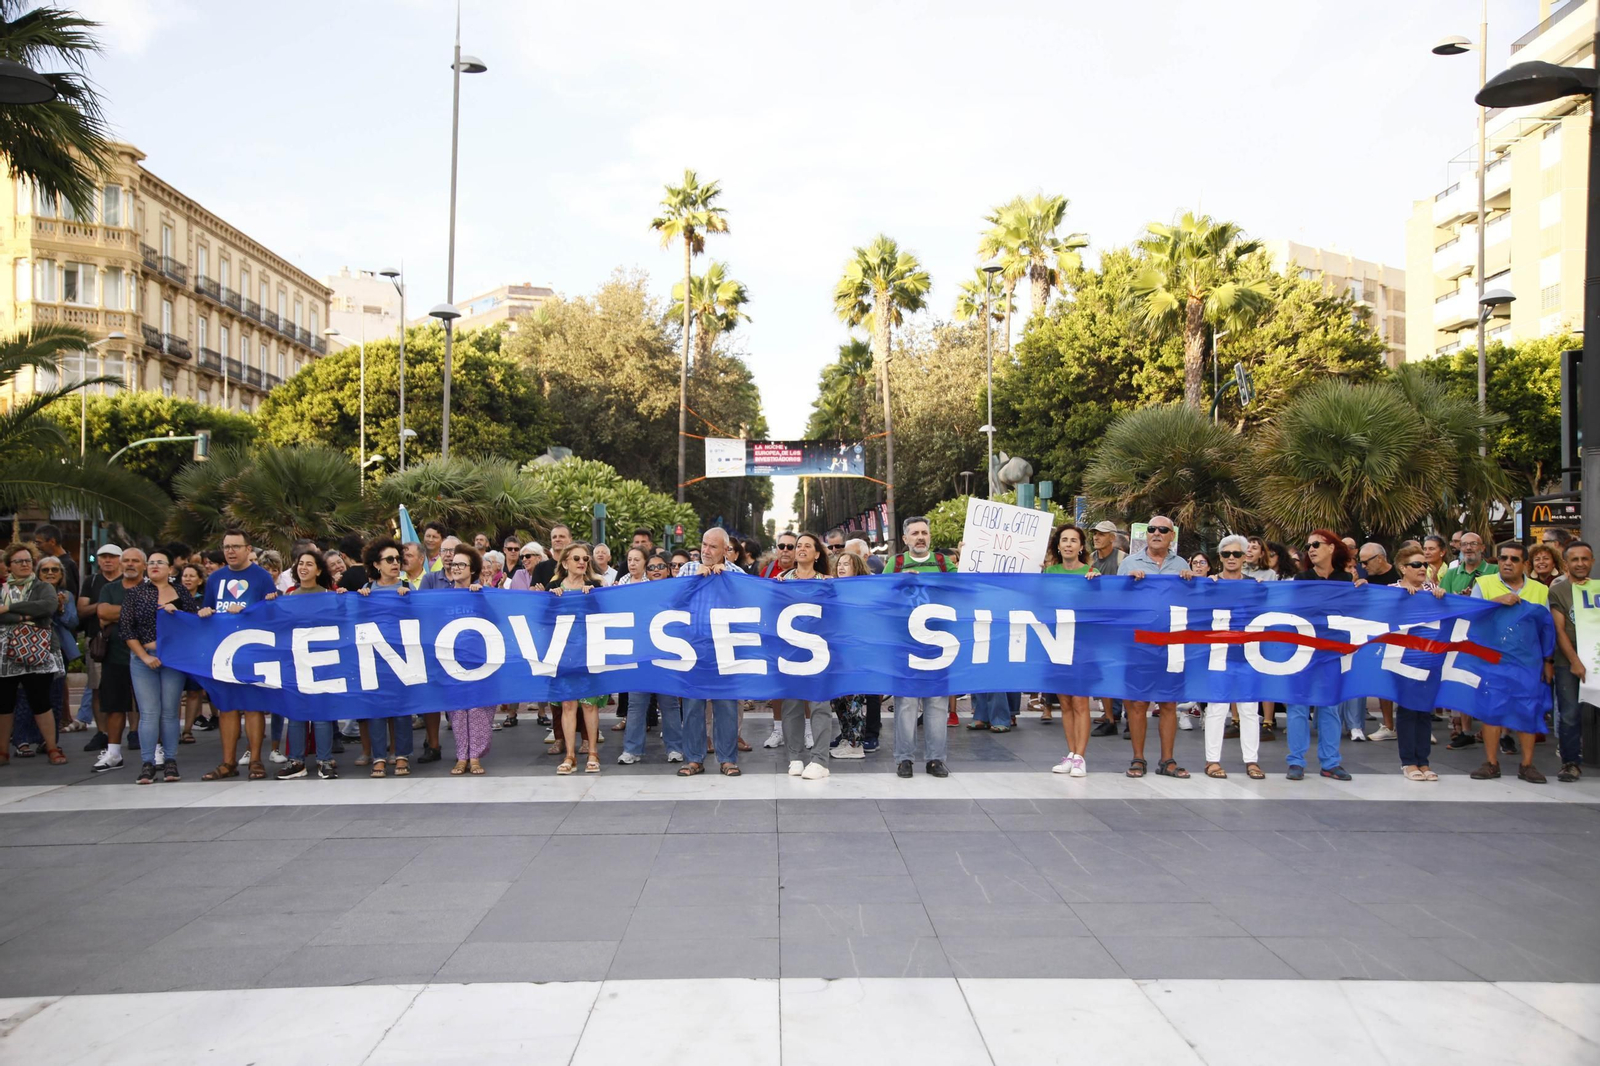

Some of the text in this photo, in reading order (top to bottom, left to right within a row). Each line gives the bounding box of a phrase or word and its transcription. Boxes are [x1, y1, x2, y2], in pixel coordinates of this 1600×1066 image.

[973, 505, 1003, 530] CABO
[1011, 511, 1040, 537] GATA
[993, 533, 1013, 551] NO
[968, 550, 985, 573] SE
[217, 579, 226, 600] I
[211, 602, 1482, 694] GENOVESES SIN HOTEL
